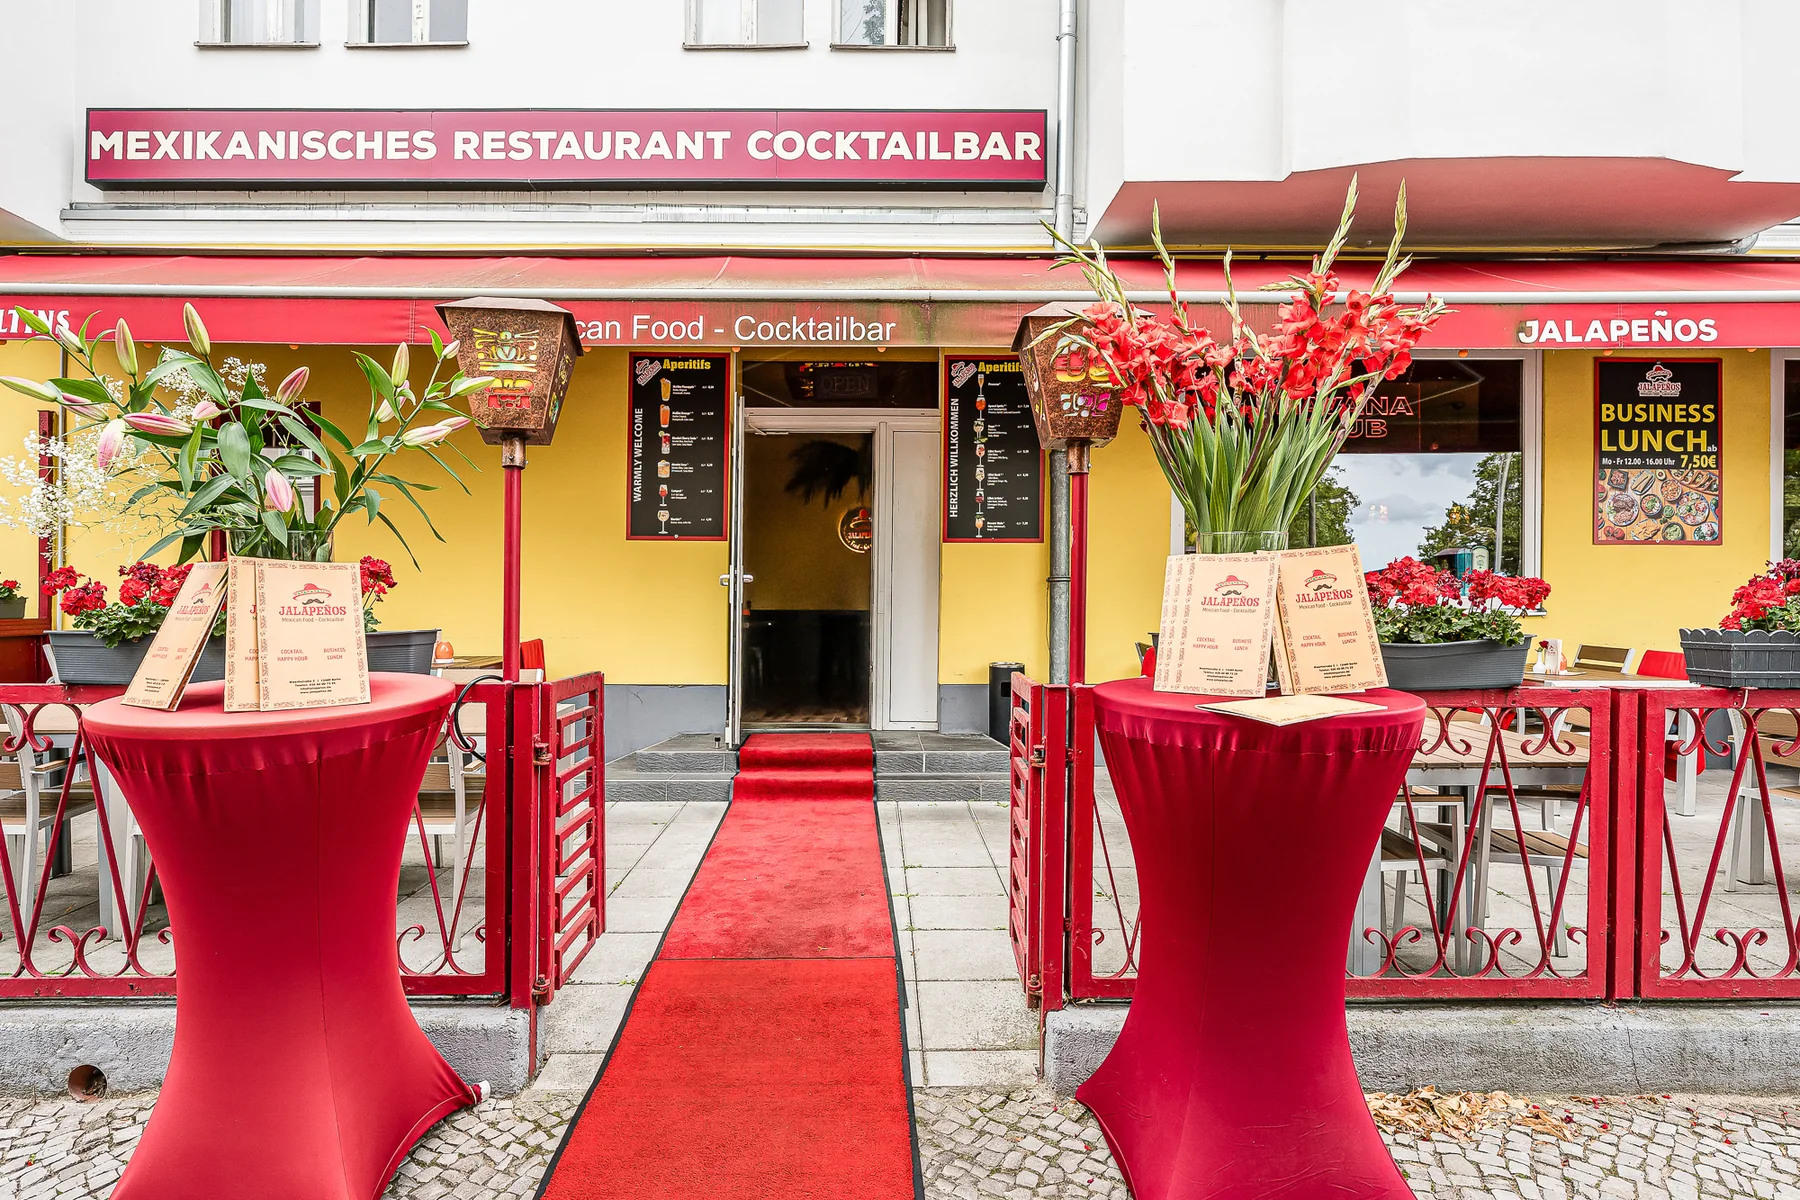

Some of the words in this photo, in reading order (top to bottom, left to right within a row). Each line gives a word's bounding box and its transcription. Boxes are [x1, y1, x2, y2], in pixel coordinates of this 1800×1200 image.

[90, 130, 438, 161] MEXIKANISCHES
[453, 130, 732, 161] RESTAURANT
[746, 130, 1042, 162] COCKTAILBAR
[632, 315, 704, 341] Food
[733, 315, 897, 342] Cocktailbar
[1518, 309, 1719, 344] JALAPEÑOS
[662, 359, 711, 372] Aperitifs
[1601, 403, 1716, 423] BUSINESS
[634, 408, 643, 458] WELCOME
[950, 398, 960, 468] WILLKOMMEN
[1601, 429, 1707, 452] LUNCH
[1680, 455, 1717, 469] 7,50€
[633, 459, 643, 502] WARMLY
[949, 468, 959, 518] HERZLICH
[1201, 596, 1260, 607] JALAPEÑOS
[1295, 589, 1353, 603] JALAPEÑOS
[279, 604, 347, 616] JALAPEÑOS
